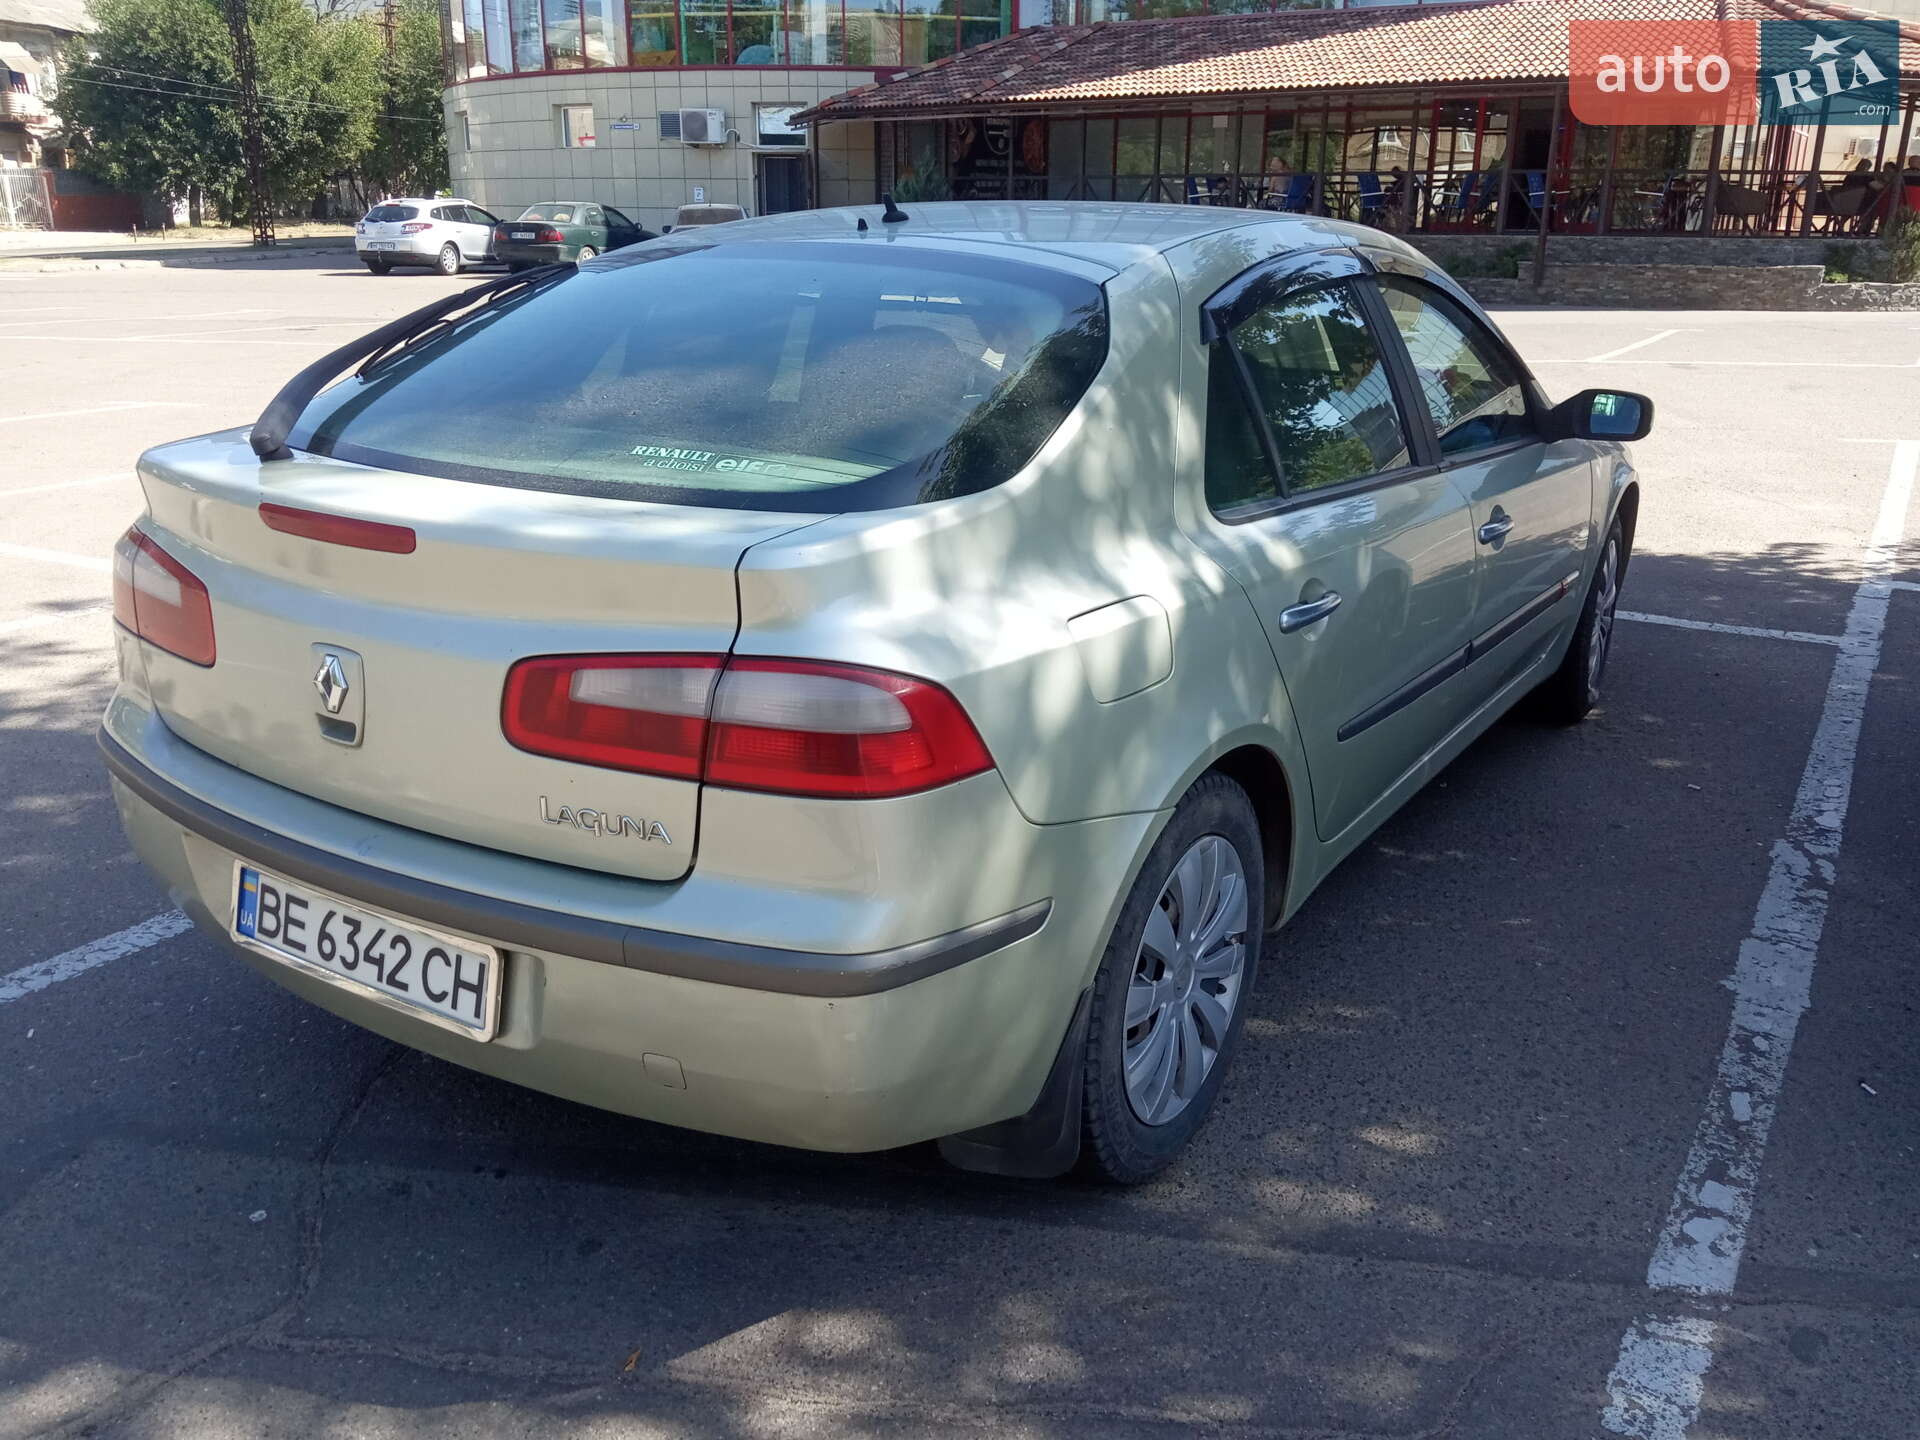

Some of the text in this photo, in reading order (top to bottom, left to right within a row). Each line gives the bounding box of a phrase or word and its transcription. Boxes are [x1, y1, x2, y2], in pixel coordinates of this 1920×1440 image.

[631, 445, 716, 462] RENAULT
[655, 456, 705, 472] choisi
[539, 796, 672, 845] LAGUNA
[240, 910, 254, 929] UA
[256, 883, 486, 1019] BE 6342 CH
